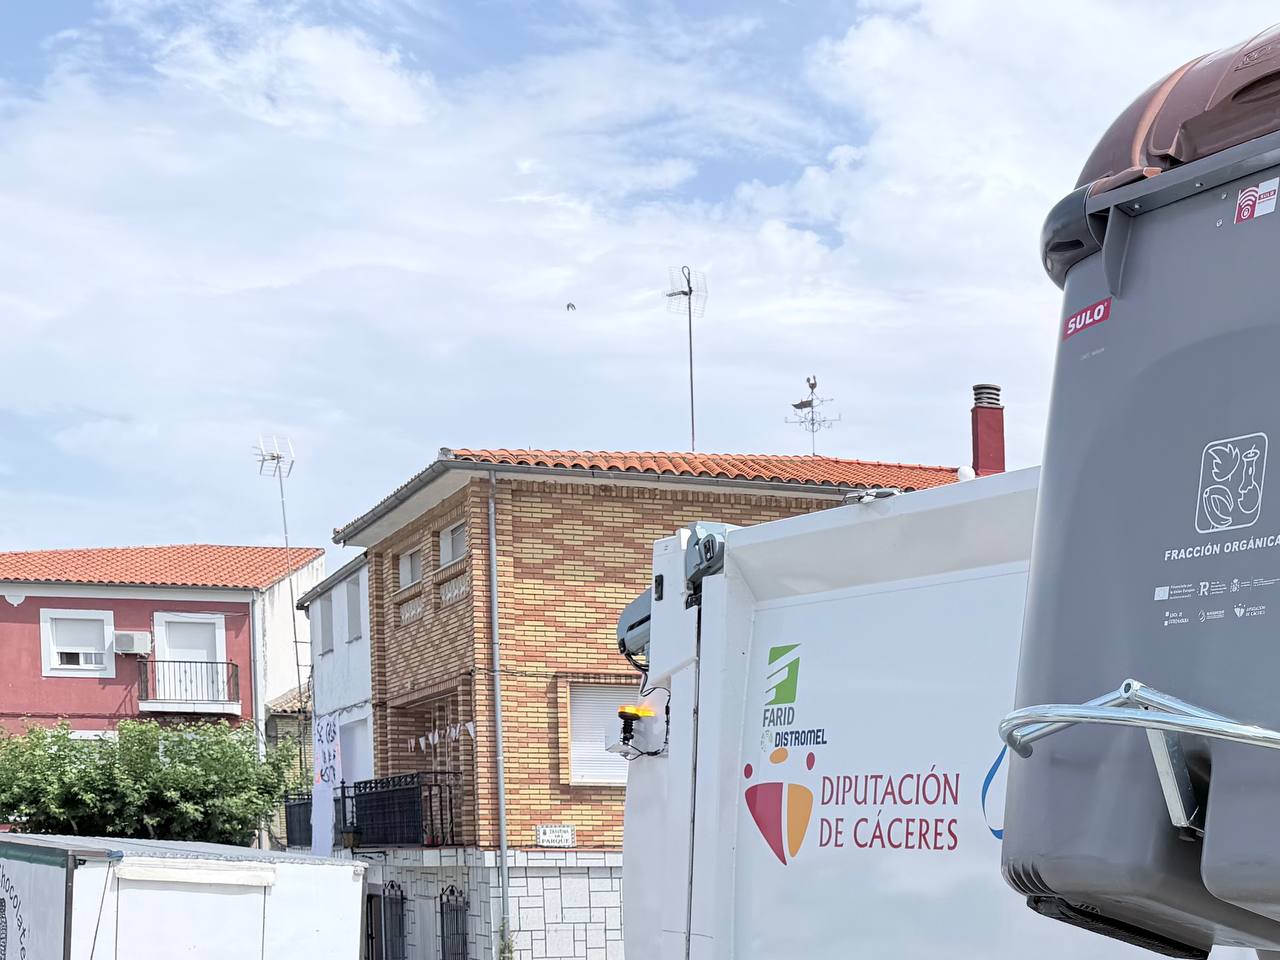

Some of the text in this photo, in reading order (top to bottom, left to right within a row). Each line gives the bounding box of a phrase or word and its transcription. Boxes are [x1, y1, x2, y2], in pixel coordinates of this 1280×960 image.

[1165, 543, 1220, 560] FRACCIÓN
[763, 707, 794, 727] FARID
[775, 728, 827, 747] DISTROMEL
[821, 764, 960, 805] DIPUTACIÓN
[819, 809, 957, 850] DE CÁCERES
